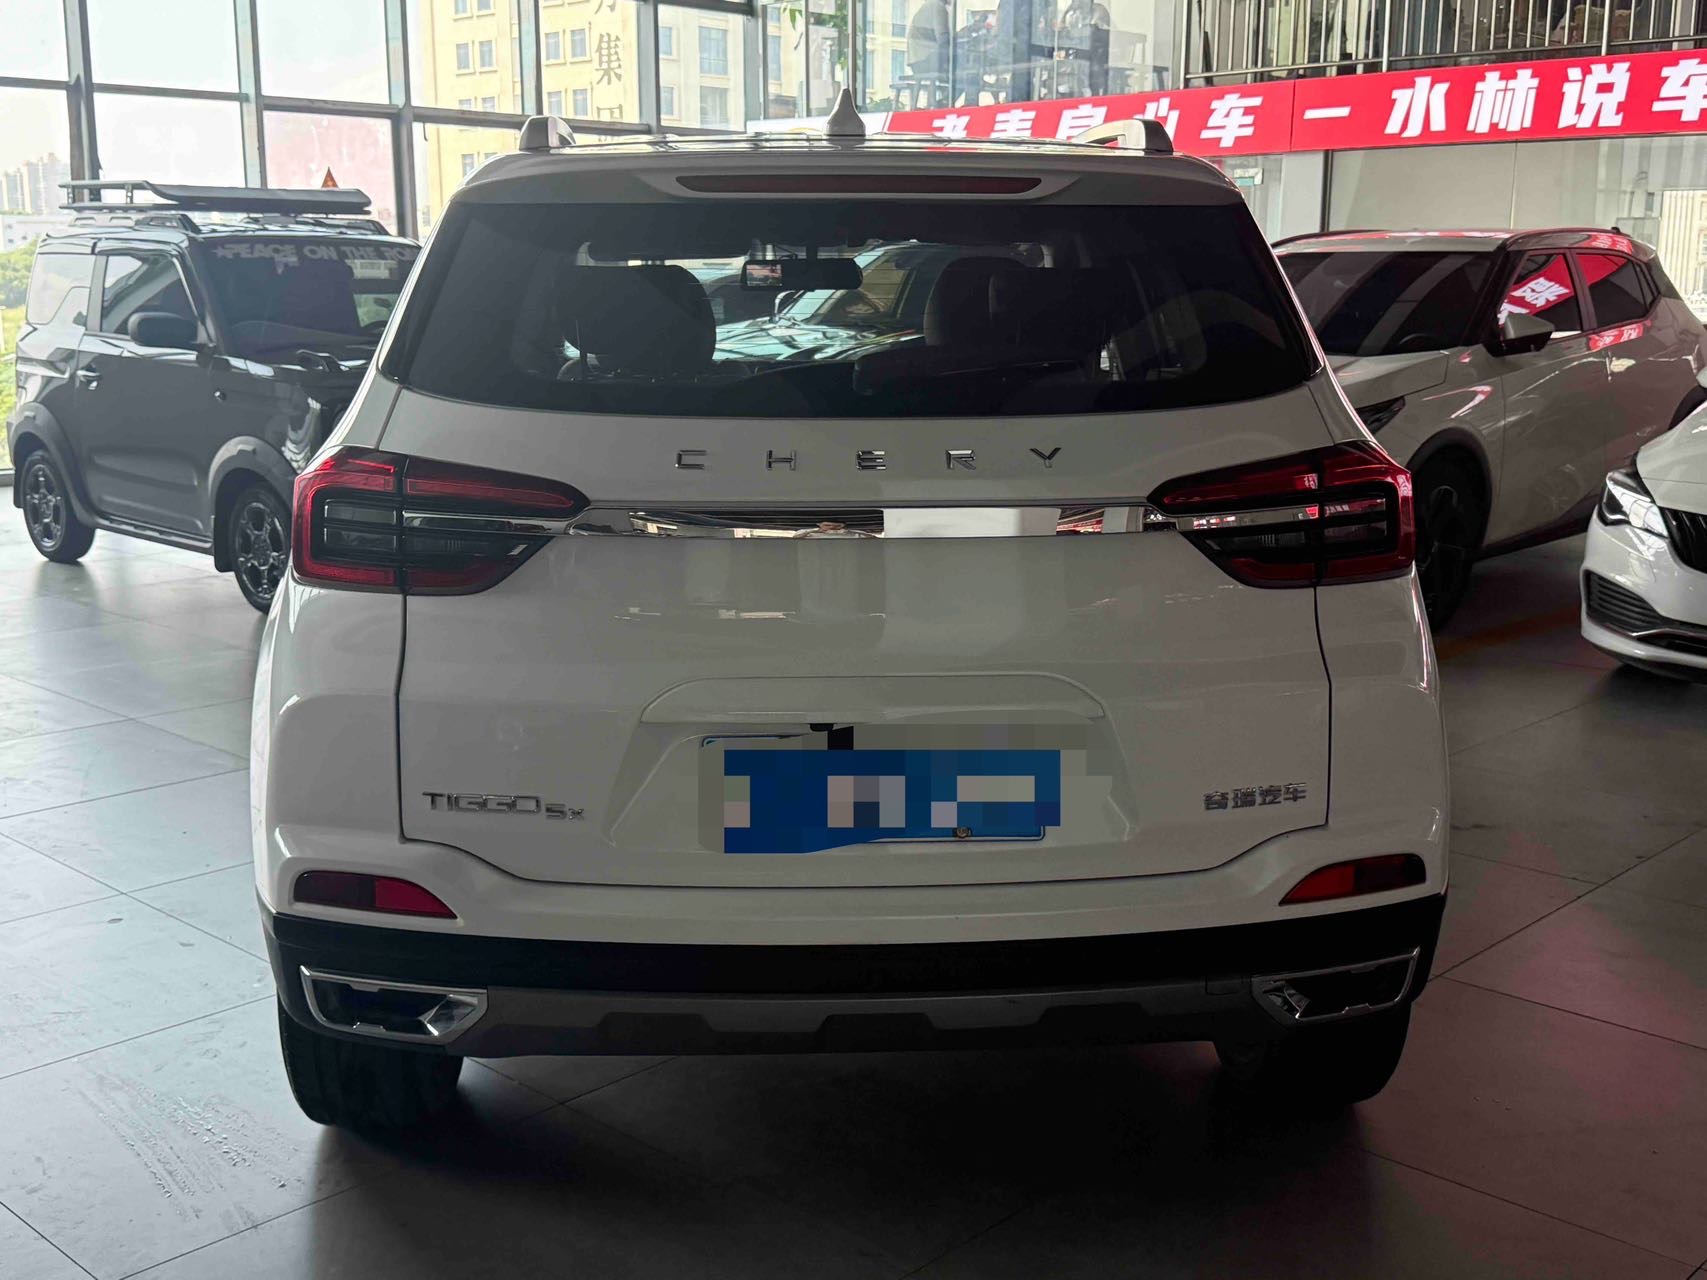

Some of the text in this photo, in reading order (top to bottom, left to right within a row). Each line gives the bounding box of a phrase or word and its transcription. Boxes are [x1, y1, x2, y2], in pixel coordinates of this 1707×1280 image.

[303, 245, 338, 260] ON
[340, 245, 377, 261] THE
[674, 446, 1062, 472] CHERY
